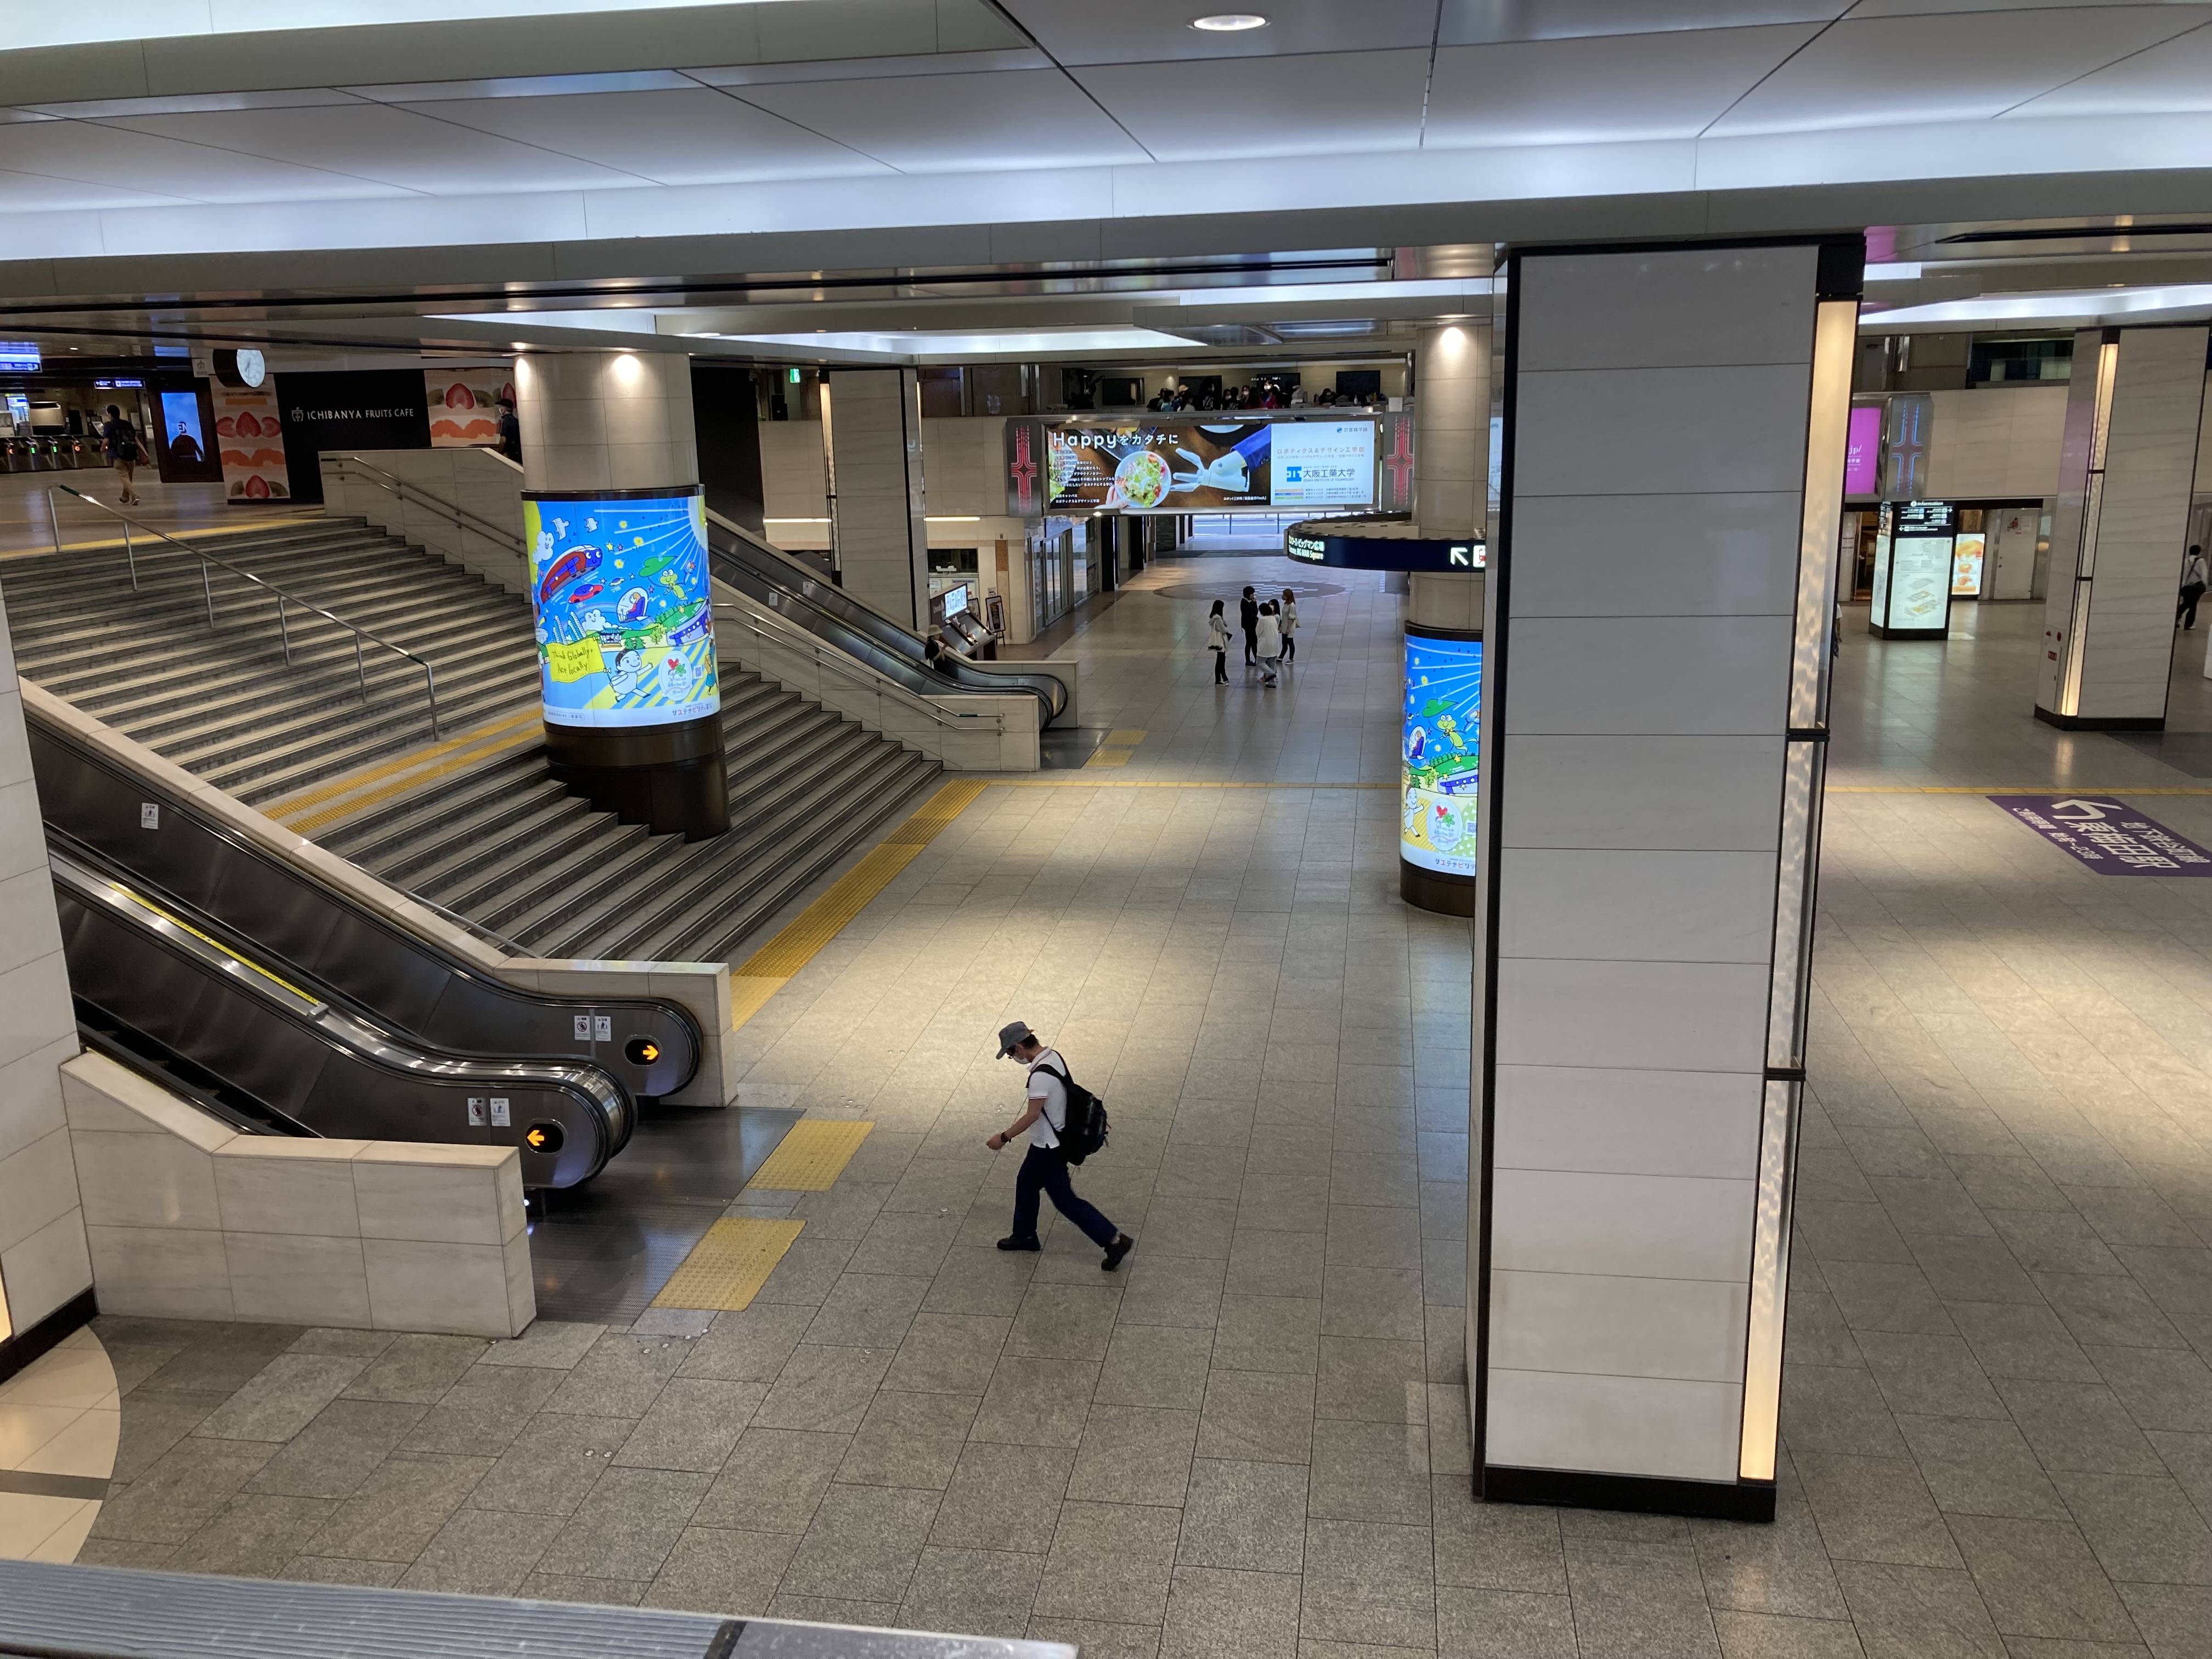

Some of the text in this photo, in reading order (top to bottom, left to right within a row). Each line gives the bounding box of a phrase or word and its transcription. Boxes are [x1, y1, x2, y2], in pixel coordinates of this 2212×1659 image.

[307, 408, 414, 420] ICHIBANYA FRUITS CAFE
[1052, 431, 1178, 449] Happyをカタチに
[1303, 468, 1355, 478] 大阪工業大学
[1310, 550, 1324, 561] Square
[2063, 821, 2181, 869] 東梅田駅
[2121, 821, 2211, 864] 地下鉄谷町線
